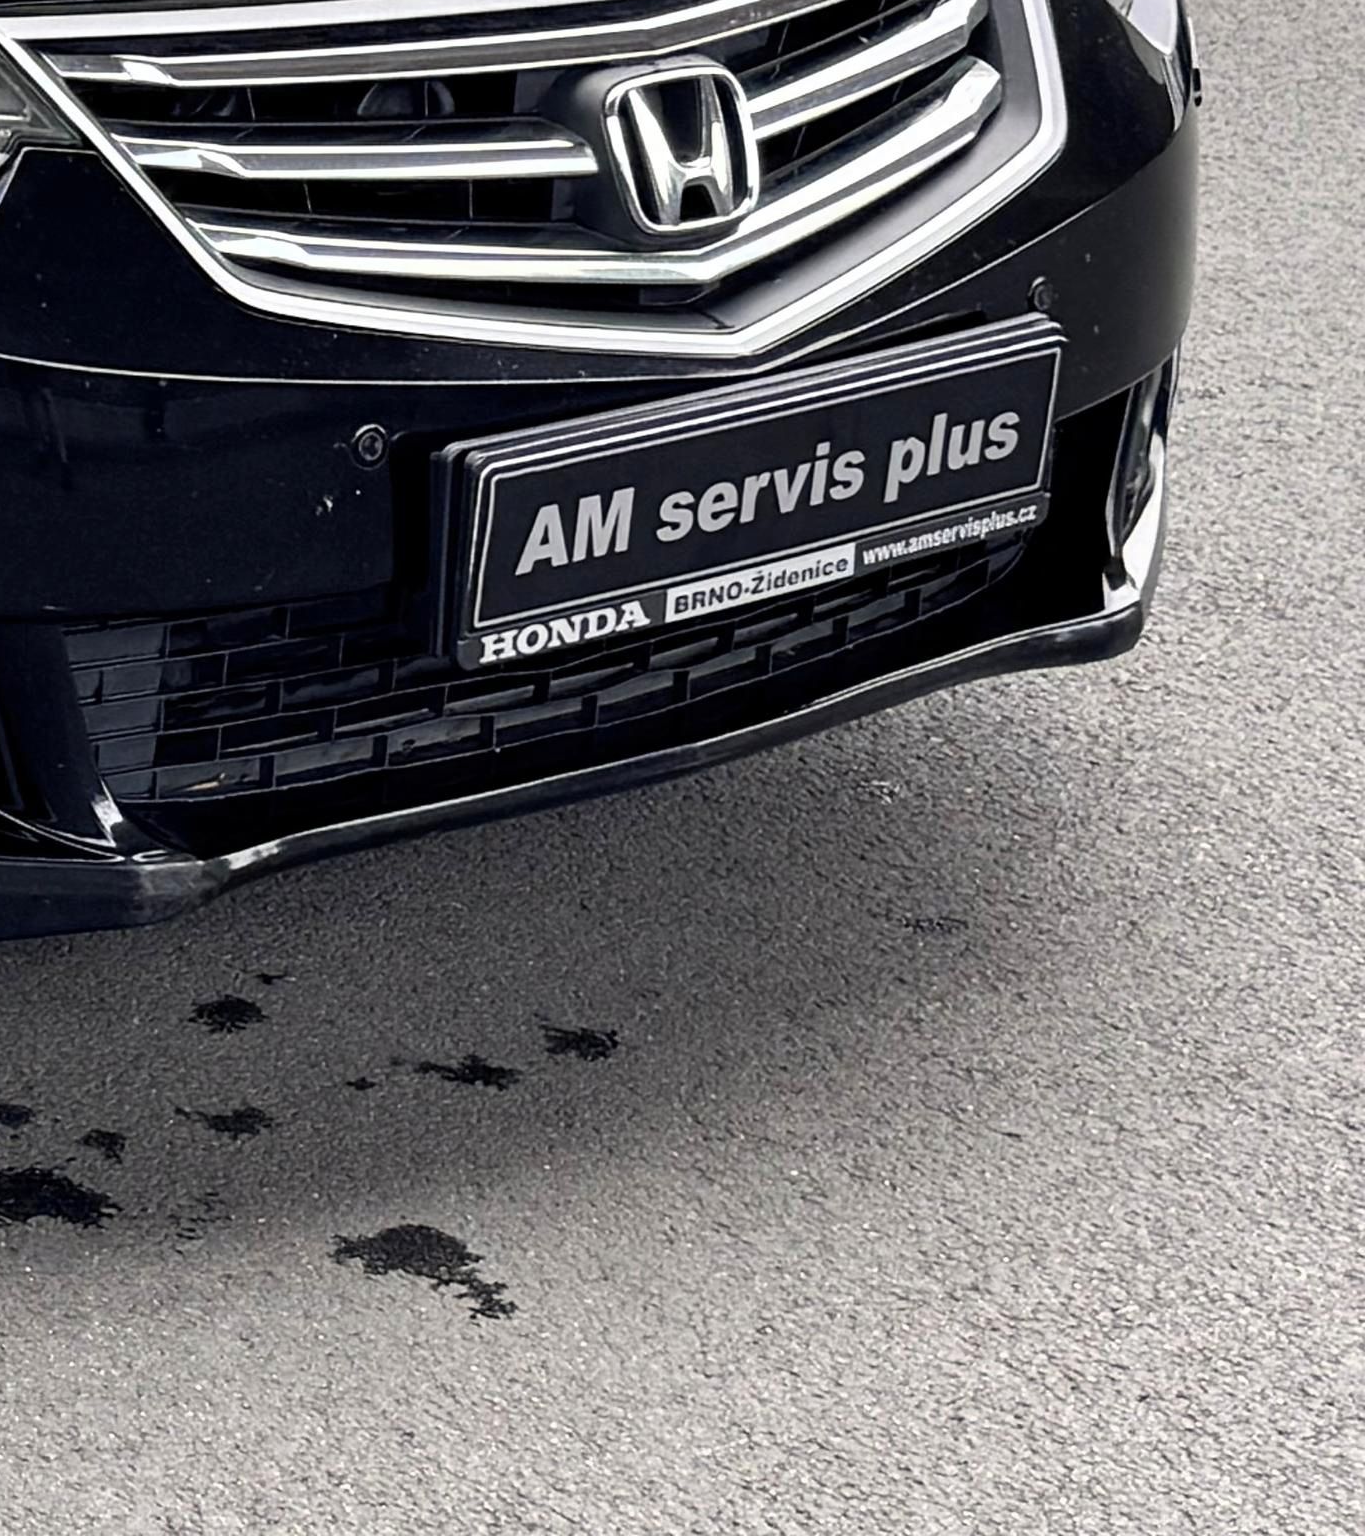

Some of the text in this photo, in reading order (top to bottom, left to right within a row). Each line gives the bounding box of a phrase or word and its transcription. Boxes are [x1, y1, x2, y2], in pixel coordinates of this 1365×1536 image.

[514, 410, 1020, 577] AM servis plus
[479, 504, 1038, 664] HONDA BRNO-Židenice www.amservisplus.cz
